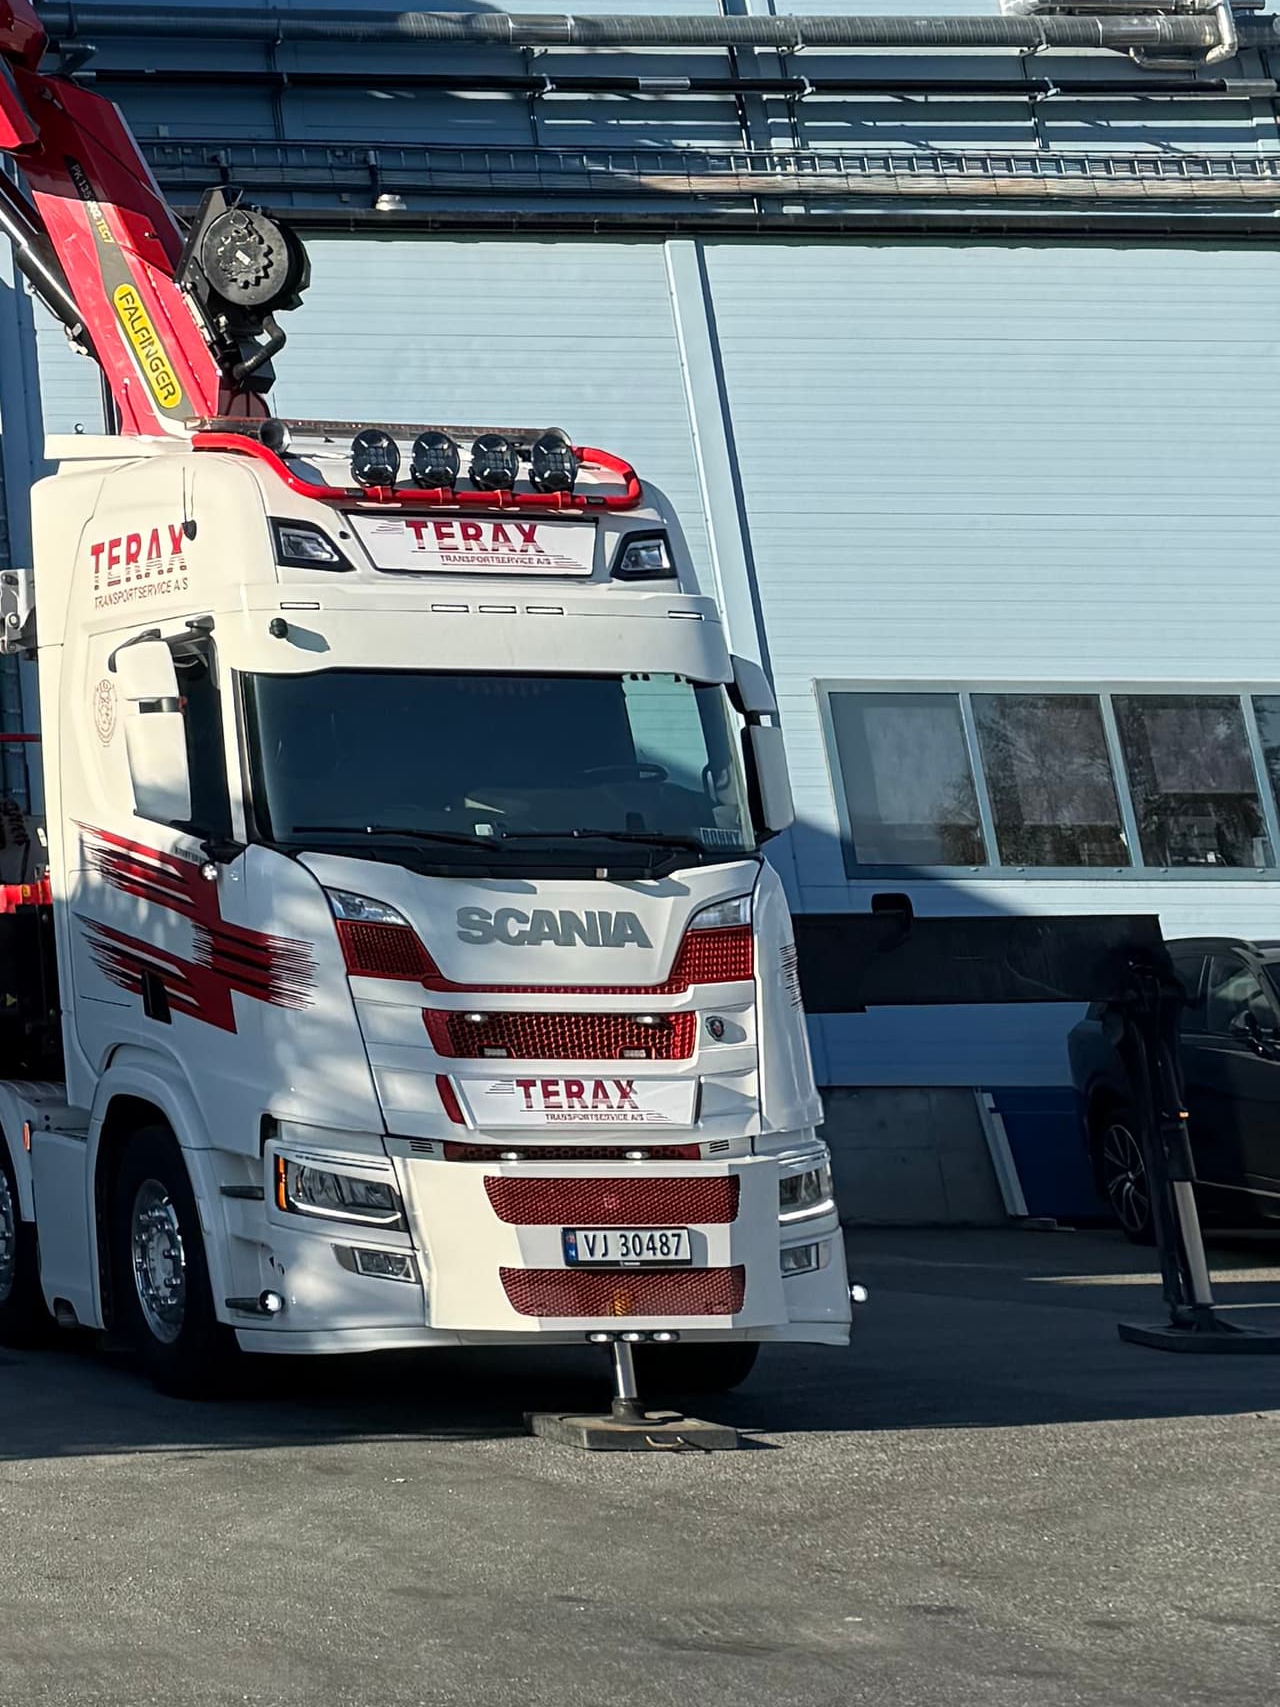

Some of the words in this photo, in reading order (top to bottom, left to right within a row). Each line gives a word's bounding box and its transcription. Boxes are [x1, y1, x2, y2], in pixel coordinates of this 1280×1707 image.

[118, 290, 176, 401] PALFINGER
[405, 519, 545, 553] TERAX
[90, 524, 188, 591] TERAX
[440, 554, 535, 565] TRANSPORTSERVICE
[456, 906, 654, 949] SCANIA
[515, 1078, 639, 1109] TERAX
[545, 1113, 628, 1122] TRANSPORTSERVICE
[583, 1234, 609, 1258] VJ
[618, 1233, 682, 1257] 30487
